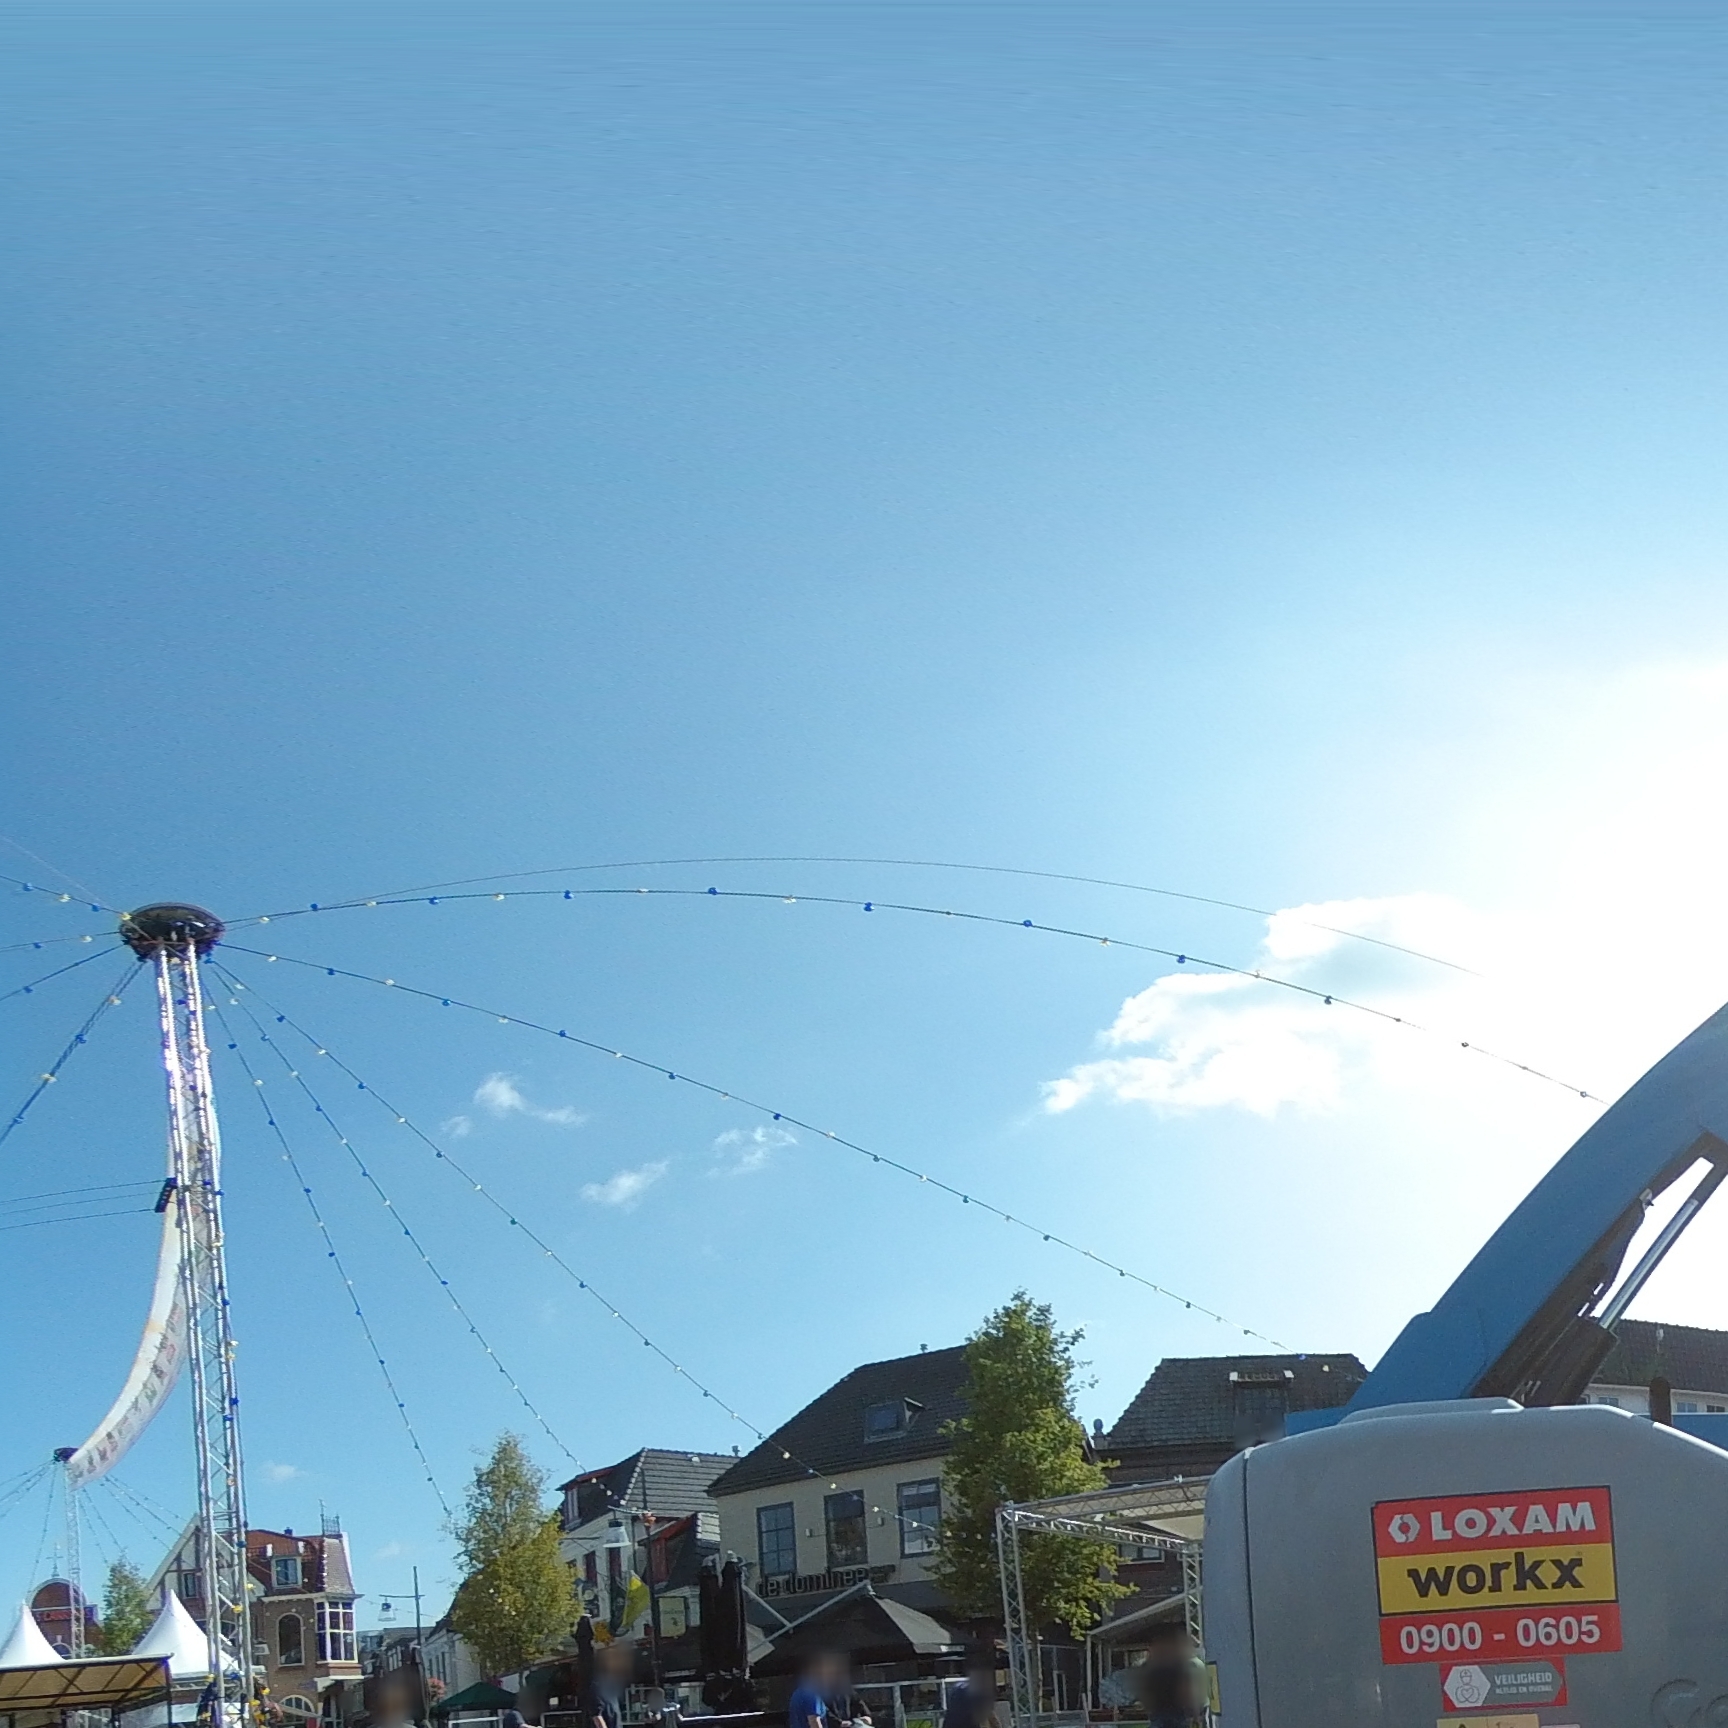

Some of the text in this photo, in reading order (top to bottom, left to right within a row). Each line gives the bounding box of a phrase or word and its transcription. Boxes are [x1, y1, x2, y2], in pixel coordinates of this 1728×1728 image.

[1430, 1501, 1597, 1541] LOXAM
[1407, 1551, 1585, 1598] workx
[1400, 1621, 1483, 1655] 0900
[1516, 1614, 1601, 1648] 0605
[1494, 1671, 1553, 1686] VEILIGHEID
